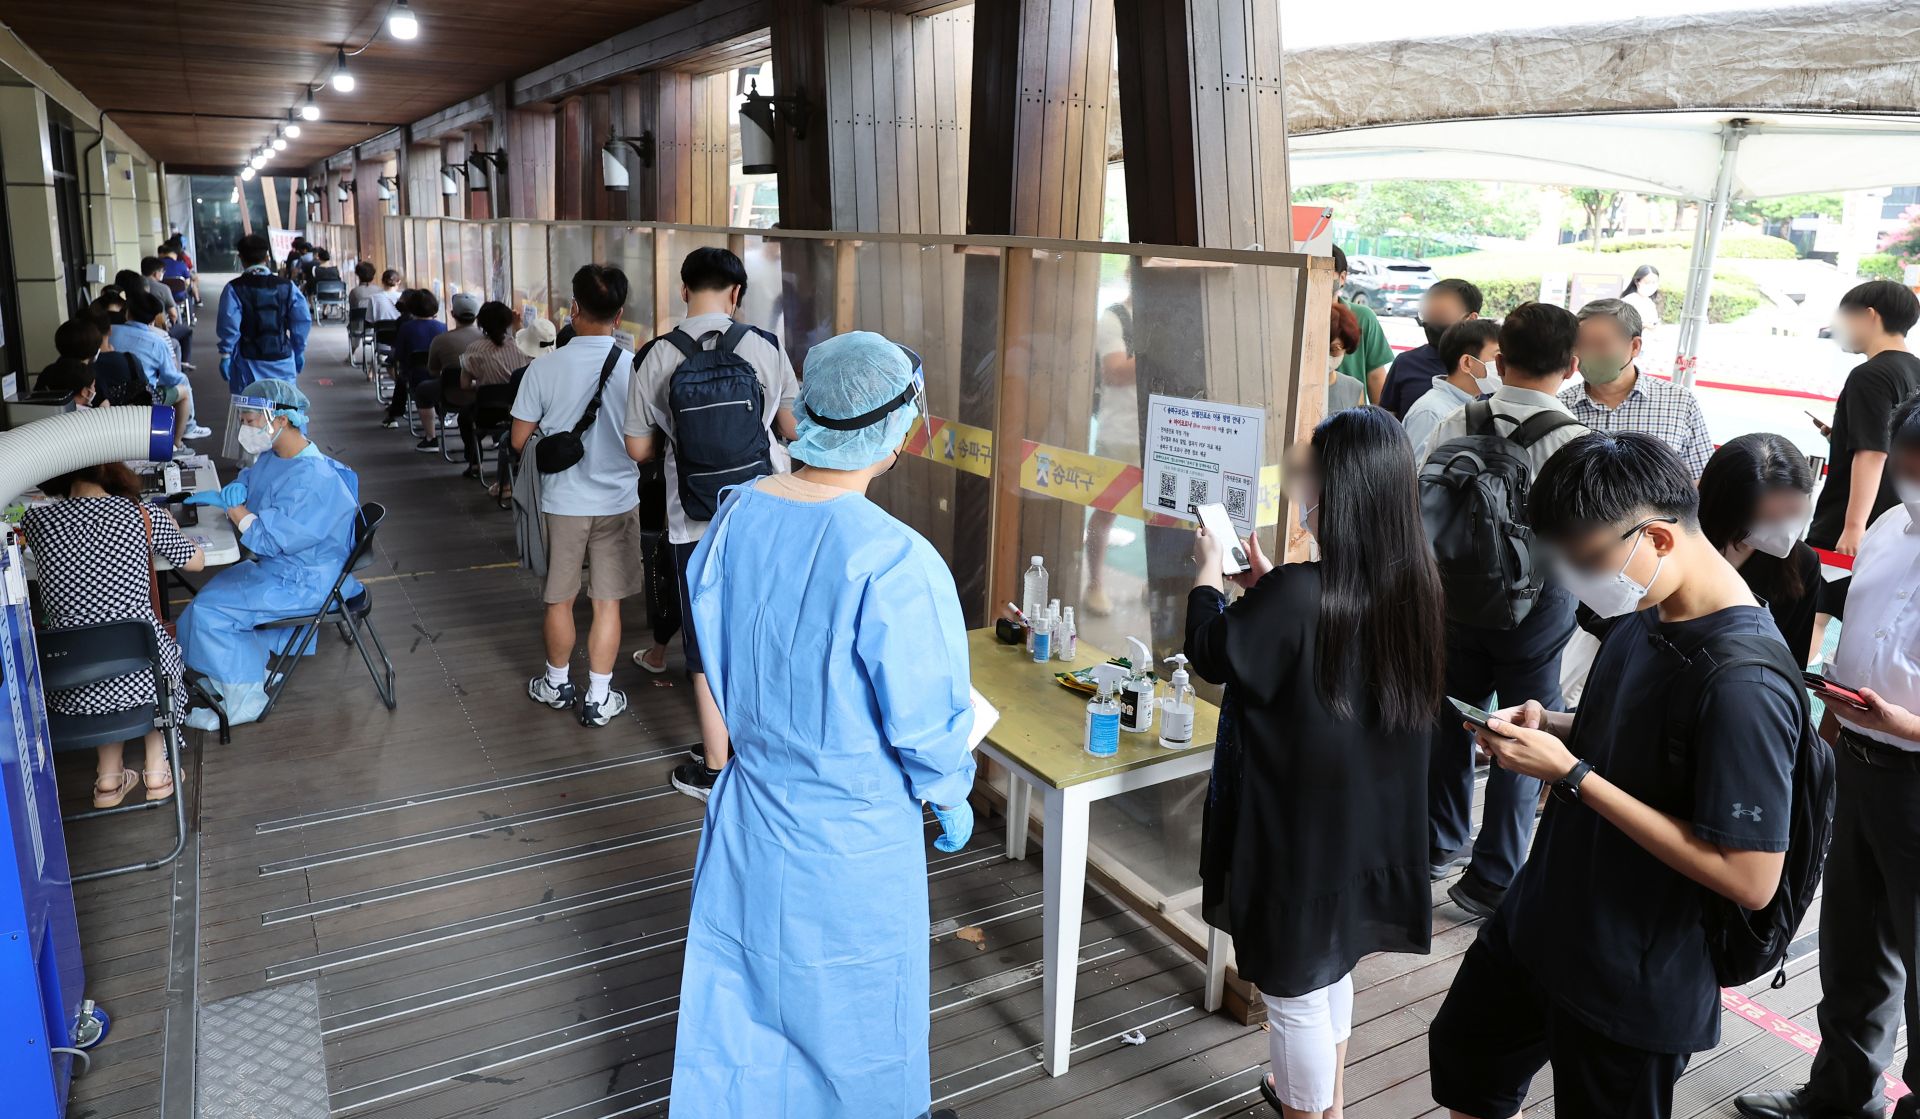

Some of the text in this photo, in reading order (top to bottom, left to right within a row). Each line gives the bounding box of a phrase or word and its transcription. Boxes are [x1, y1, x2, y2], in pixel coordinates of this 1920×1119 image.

[957, 437, 992, 465] 송파구
[1052, 465, 1095, 492] 송파구
[1721, 992, 1767, 1020] 입구
